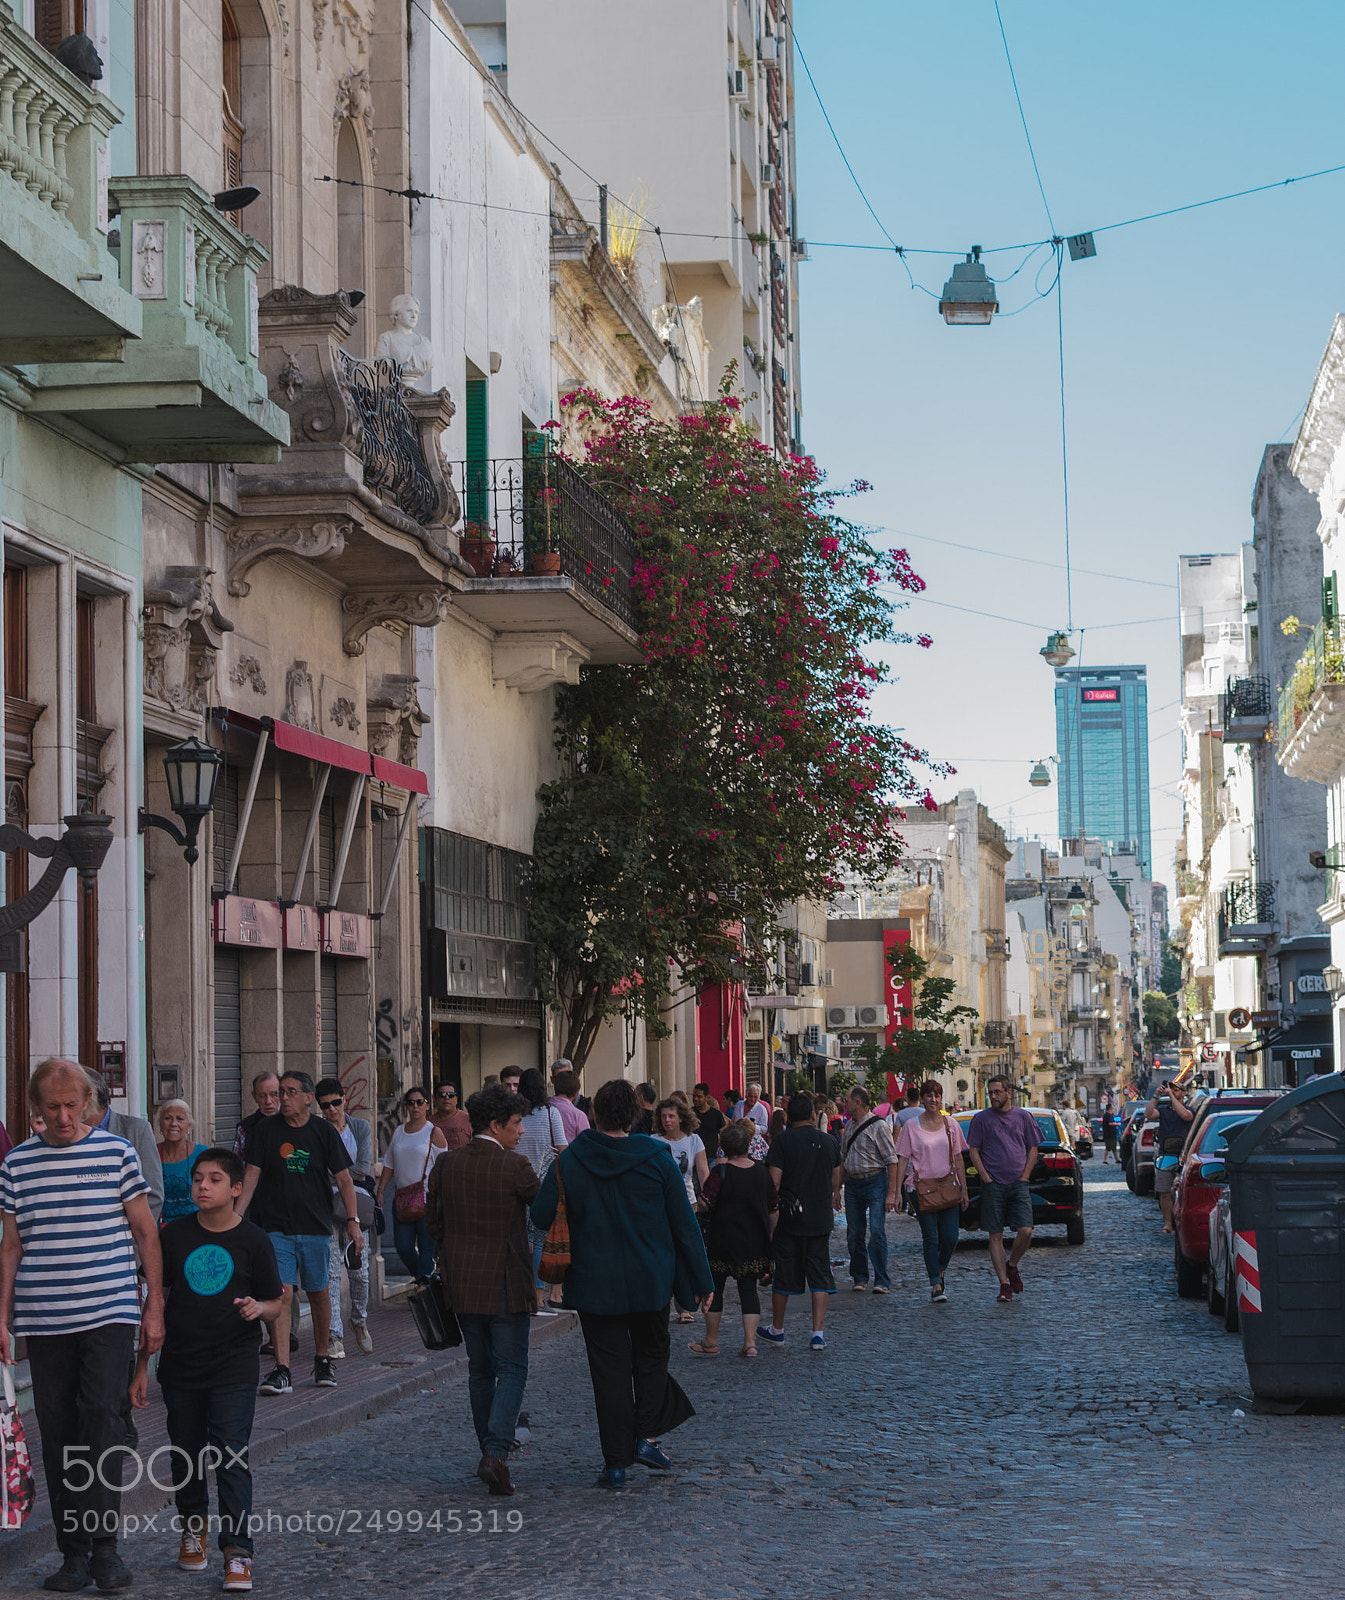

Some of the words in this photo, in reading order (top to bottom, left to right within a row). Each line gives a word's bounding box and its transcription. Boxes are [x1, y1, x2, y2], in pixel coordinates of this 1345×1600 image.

[1074, 235, 1086, 246] 10
[1080, 247, 1088, 257] 3
[1291, 1049, 1321, 1058] CERVELAR
